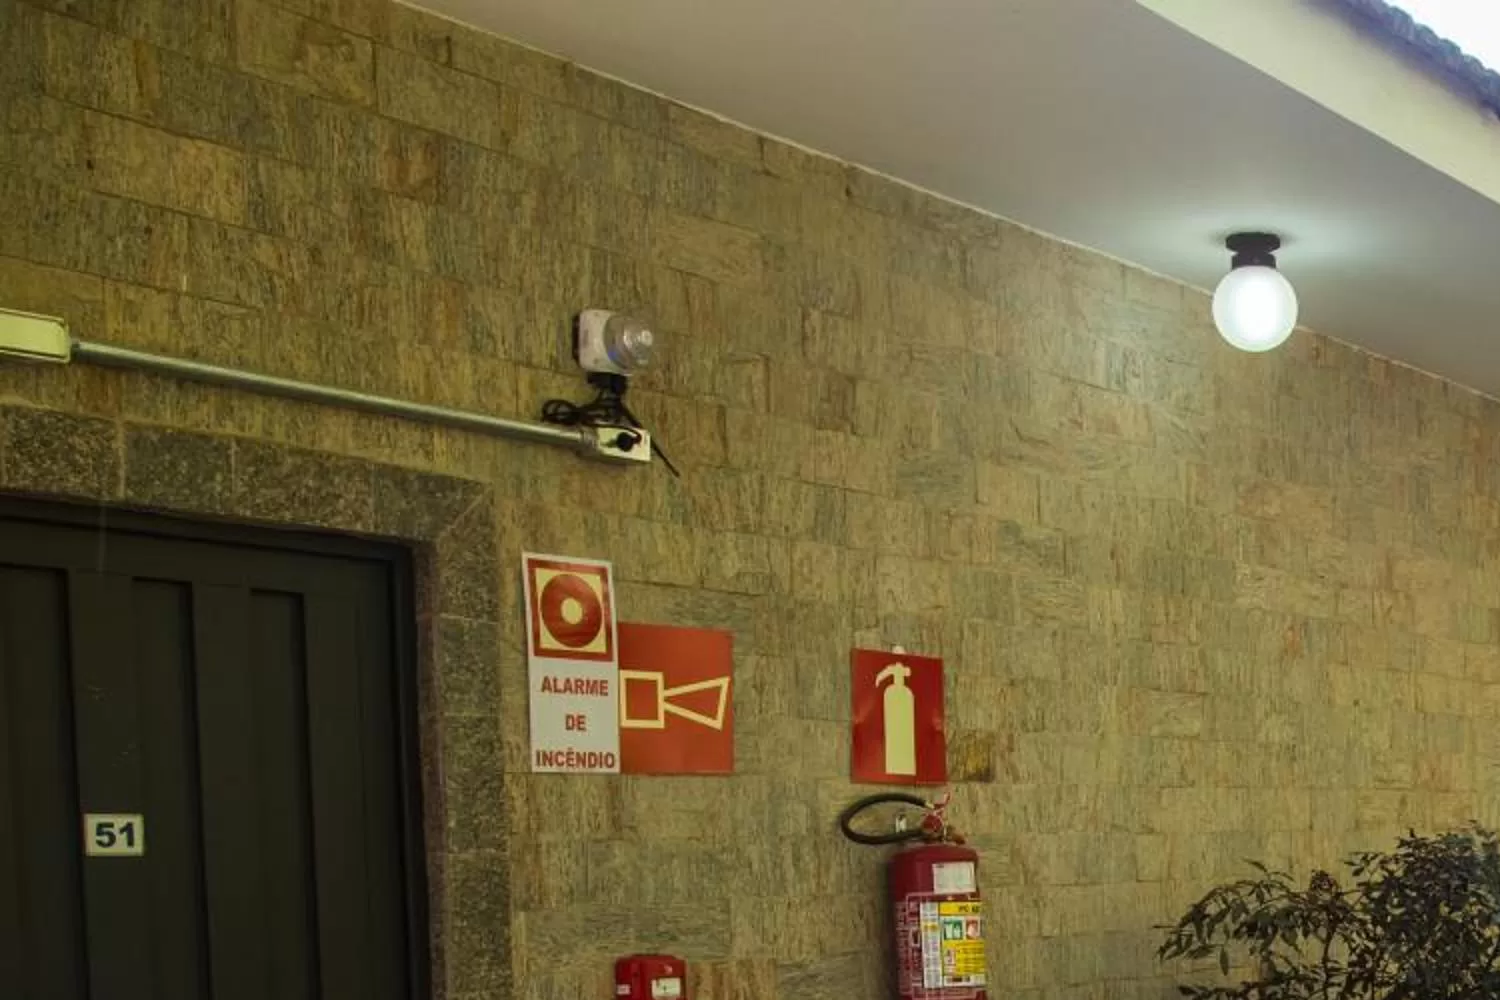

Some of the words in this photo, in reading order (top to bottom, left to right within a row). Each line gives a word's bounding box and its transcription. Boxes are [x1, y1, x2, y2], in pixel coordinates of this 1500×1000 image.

[541, 676, 608, 696] ALARME
[565, 714, 586, 732] DE
[536, 747, 615, 769] INCÊNDIO
[95, 821, 135, 848] 51
